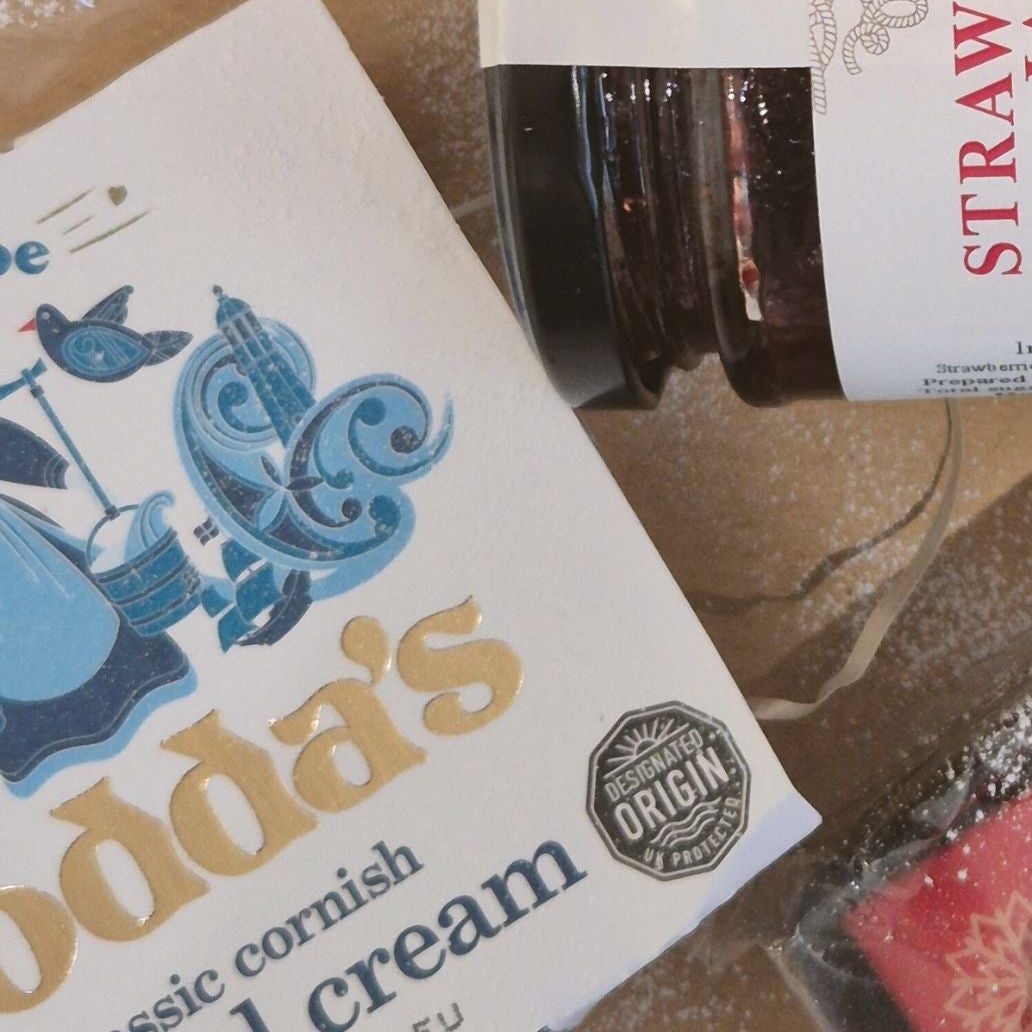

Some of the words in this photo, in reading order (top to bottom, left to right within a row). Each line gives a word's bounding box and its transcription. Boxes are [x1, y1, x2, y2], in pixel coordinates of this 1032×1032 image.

[922, 374, 1027, 388] Prepared
[604, 728, 704, 802] DESIGNATED
[614, 746, 730, 841] ORIGIN
[643, 847, 665, 871] UK
[670, 796, 742, 868] PROTECTED
[233, 839, 426, 978] cornish
[306, 838, 589, 1032] cream
